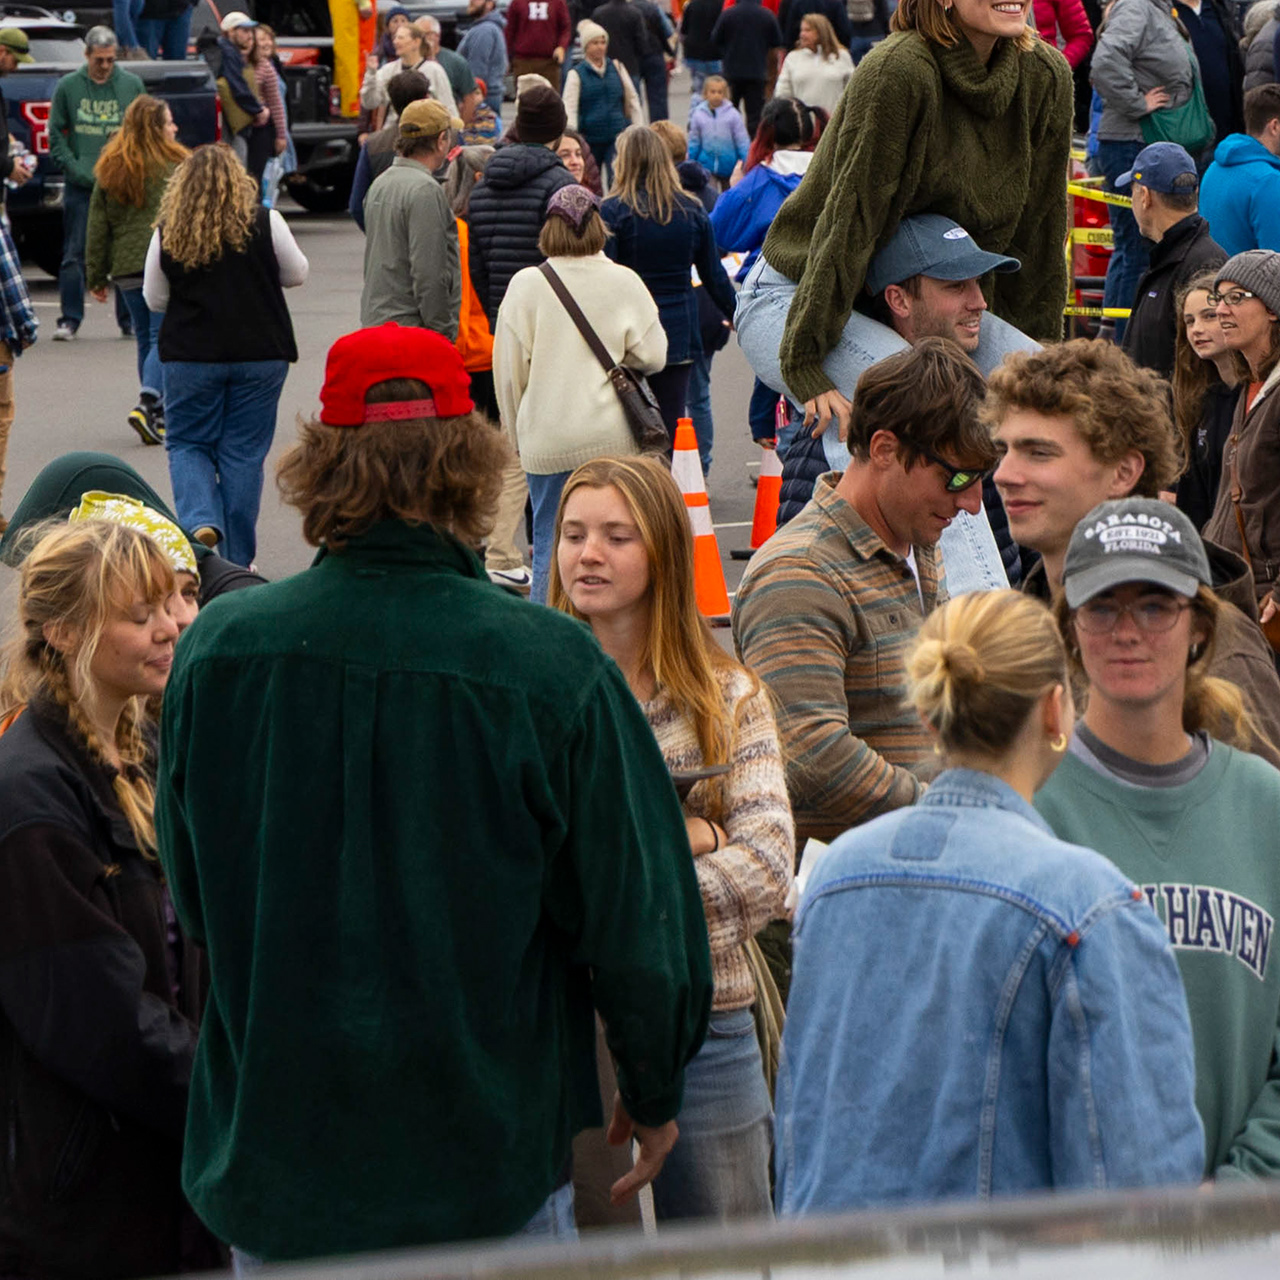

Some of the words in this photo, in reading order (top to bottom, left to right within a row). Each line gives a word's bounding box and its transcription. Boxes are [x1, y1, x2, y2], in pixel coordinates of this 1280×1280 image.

[528, 2, 549, 20] H
[1084, 513, 1181, 544] SARASOTA
[1104, 540, 1161, 554] FLORIDA
